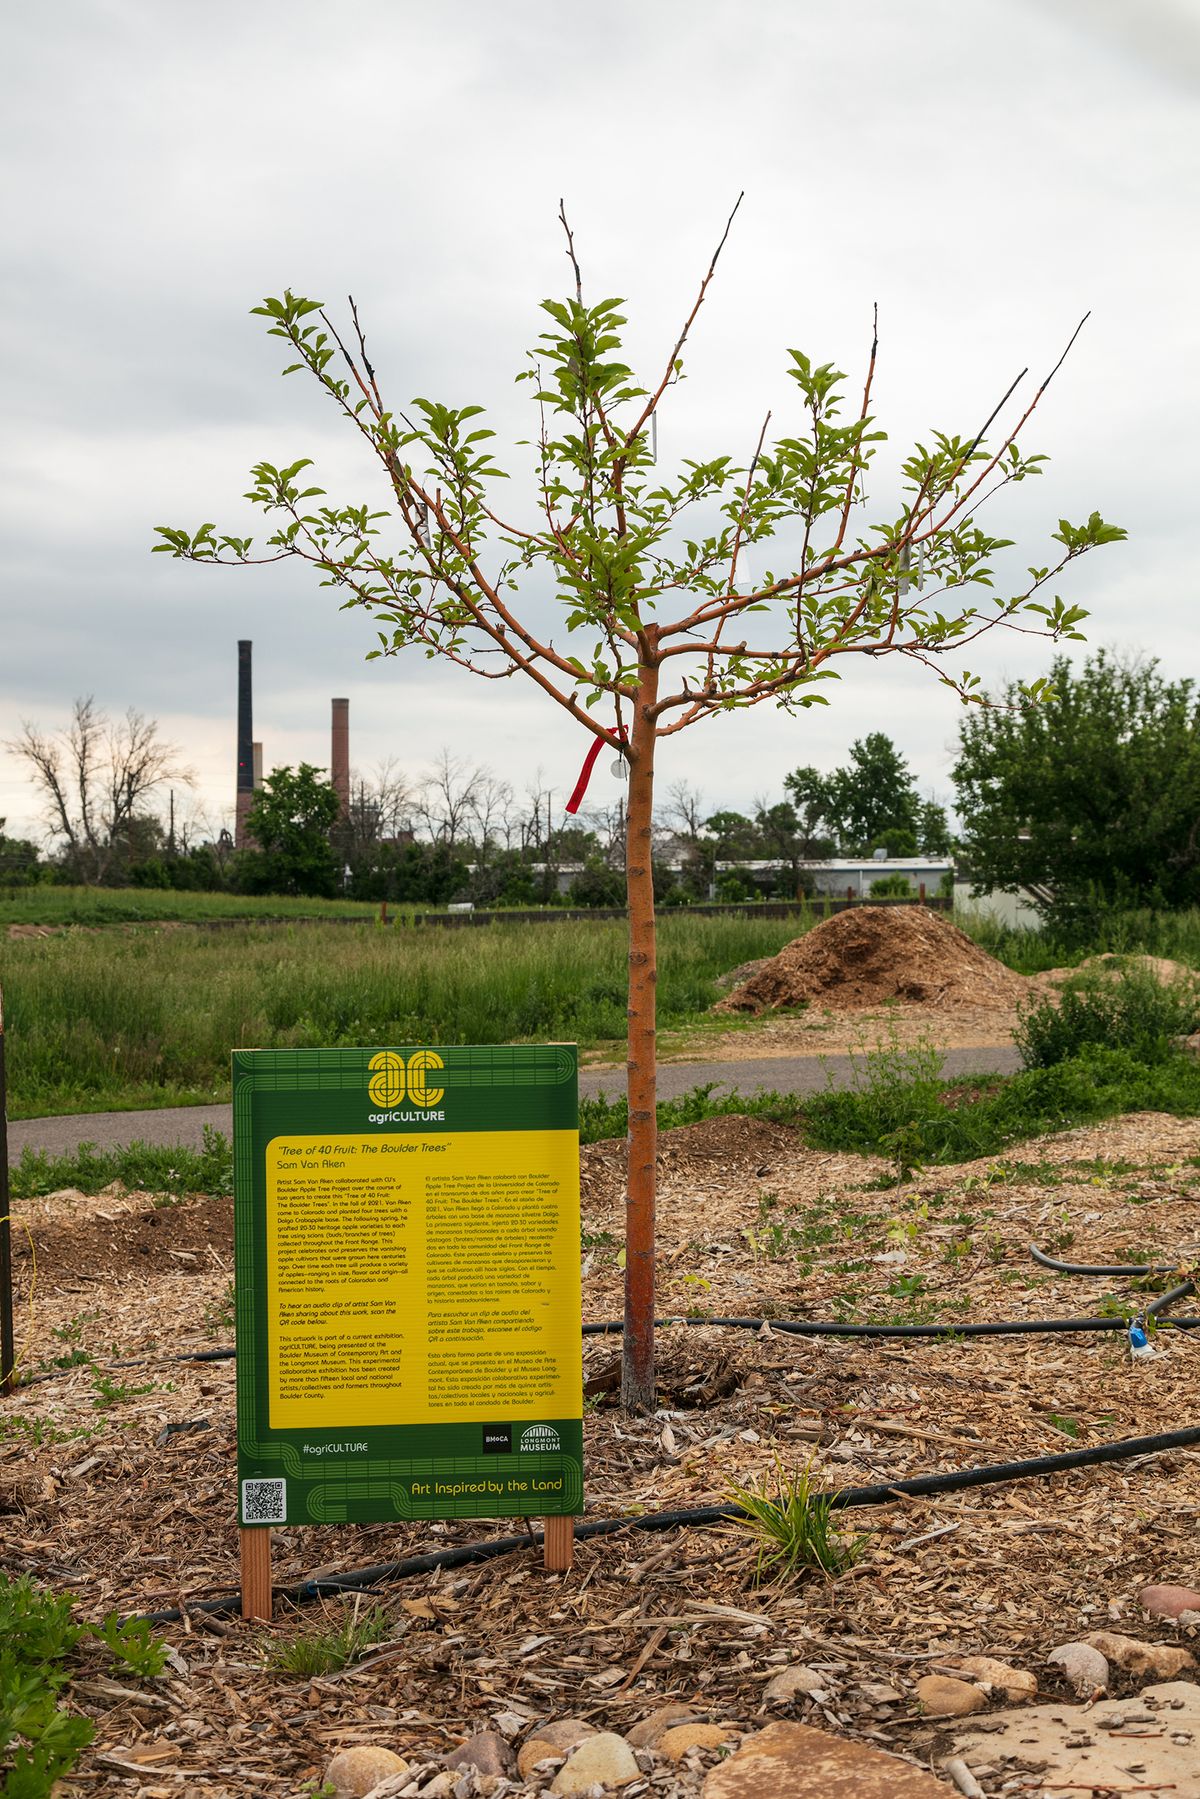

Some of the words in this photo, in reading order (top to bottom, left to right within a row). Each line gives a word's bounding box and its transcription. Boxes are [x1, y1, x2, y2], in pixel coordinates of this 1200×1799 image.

[305, 1145, 317, 1155] of
[318, 1145, 332, 1155] 40
[334, 1144, 358, 1154] Fruit:
[360, 1144, 379, 1154] The
[381, 1143, 419, 1154] Boulder
[300, 1186, 316, 1194] Apple
[332, 1185, 350, 1193] Project
[278, 1217, 294, 1225] Dolgo
[295, 1216, 324, 1225] Crabapple
[354, 1215, 379, 1224] following
[278, 1225, 298, 1233] grafted
[317, 1224, 341, 1232] heritage
[342, 1223, 358, 1232] apple
[291, 1232, 306, 1240] using
[326, 1231, 370, 1240] (buds/branches
[379, 1230, 396, 1238] trees)
[303, 1239, 333, 1248] throughout
[380, 1246, 406, 1254] vanishing
[332, 1301, 344, 1309] clip
[296, 1310, 319, 1319] sharing
[319, 1342, 336, 1351] being
[338, 1341, 368, 1350] presented
[338, 1349, 378, 1358] Contemporary
[291, 1359, 320, 1368] Longmont
[363, 1357, 401, 1366] experimental
[280, 1384, 331, 1393] artists/collectives
[370, 1382, 402, 1390] throughout
[303, 1442, 368, 1456] #agriCULTURE
[520, 1444, 560, 1452] MUSEUM
[412, 1482, 430, 1494] Art
[435, 1480, 486, 1496] Inspired
[488, 1480, 504, 1494] by
[508, 1479, 528, 1491] the
[532, 1478, 562, 1490] Land
